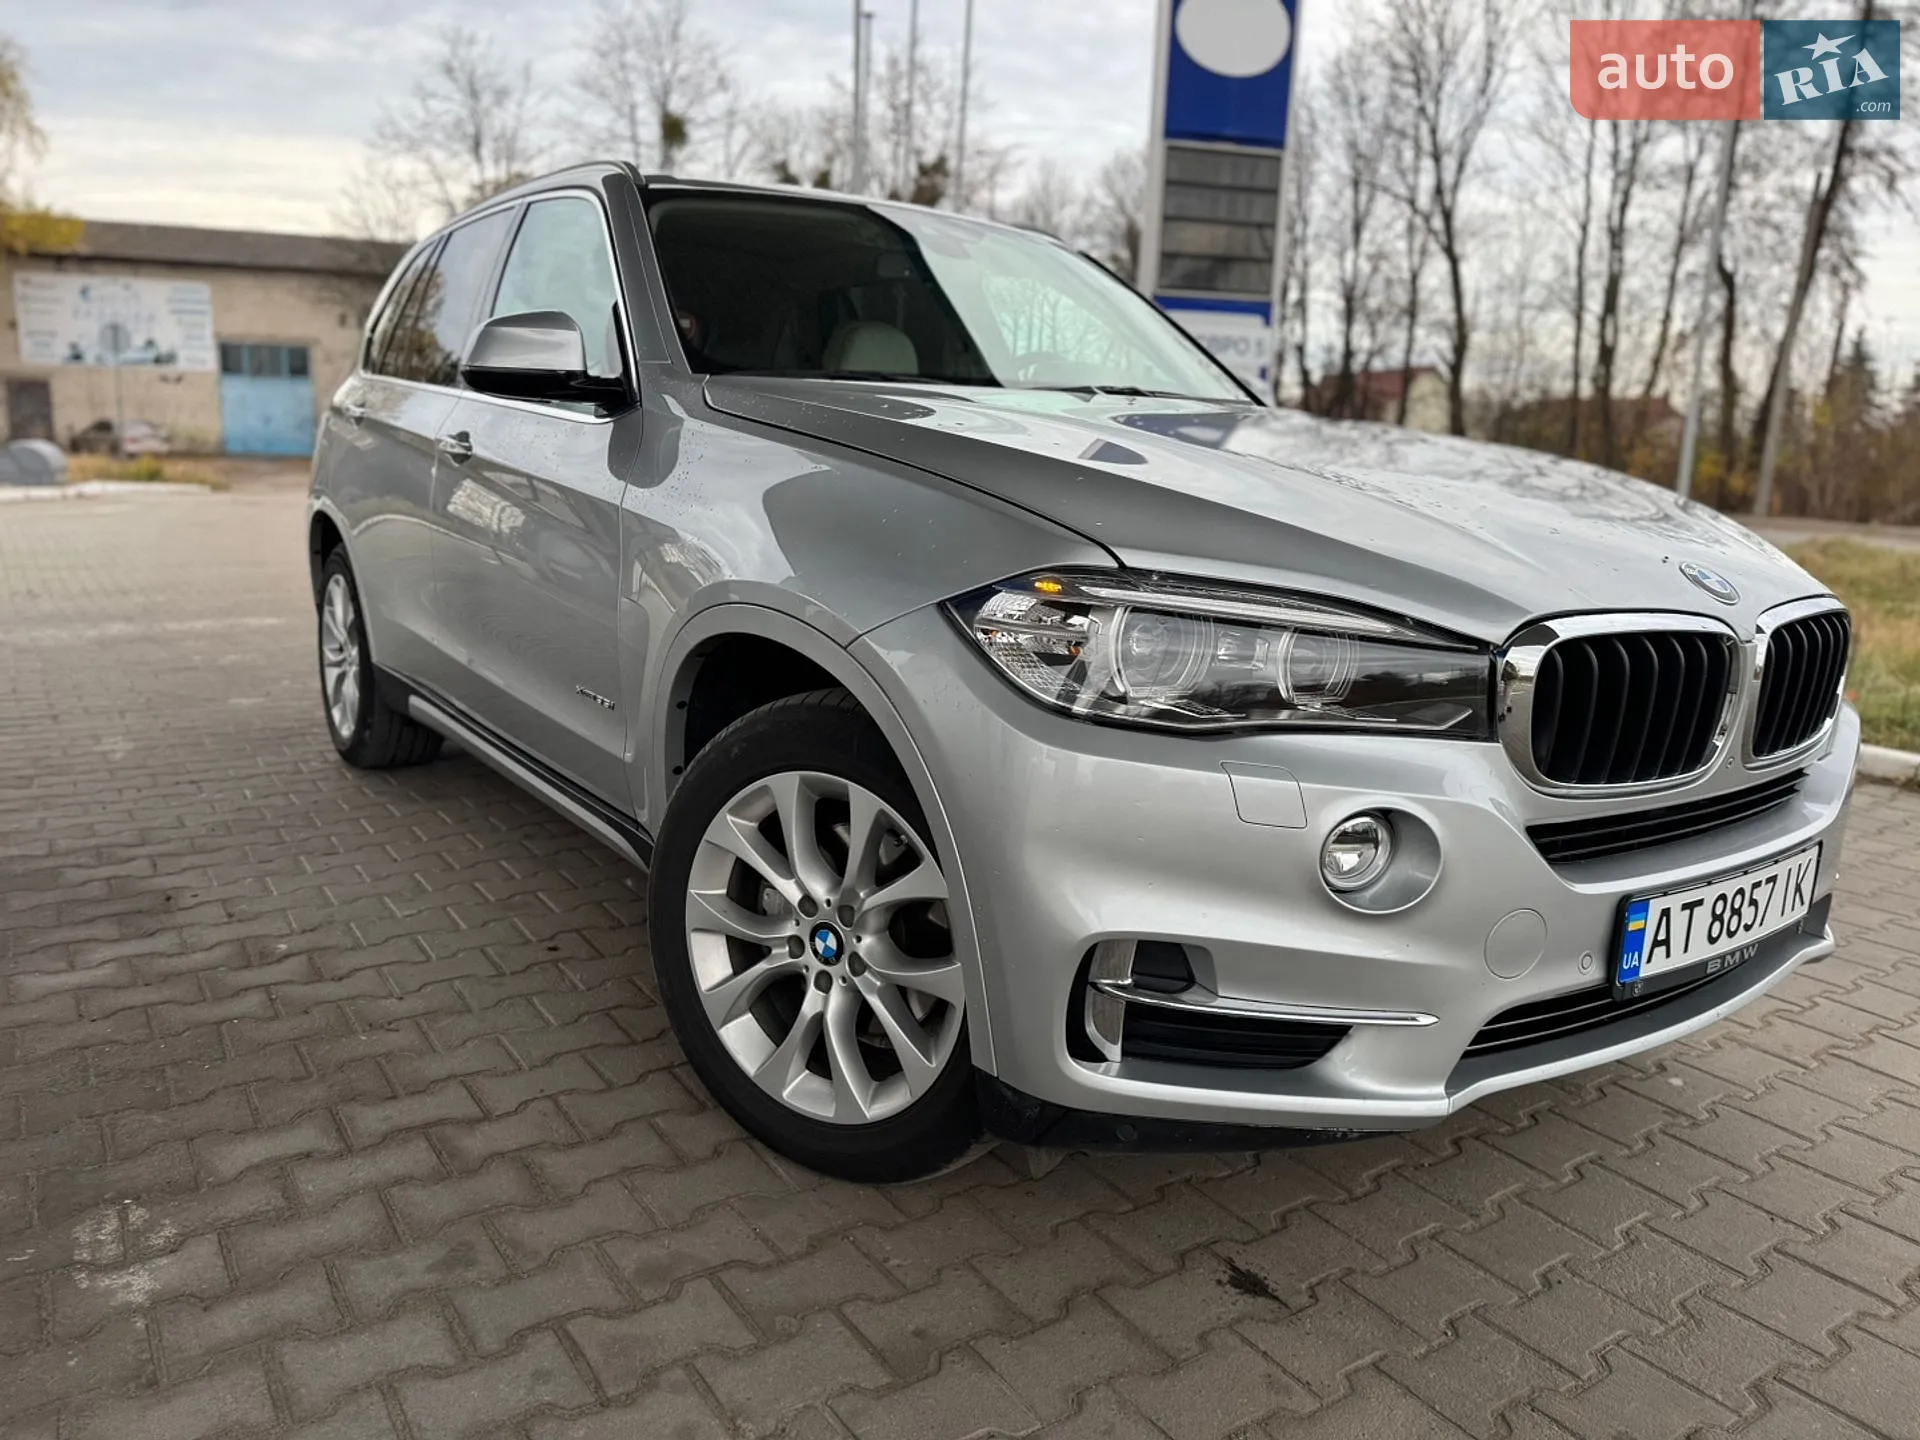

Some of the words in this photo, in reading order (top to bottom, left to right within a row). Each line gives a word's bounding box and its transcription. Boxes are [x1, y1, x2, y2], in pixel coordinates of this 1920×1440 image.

[1647, 898, 1705, 964] AT
[1707, 875, 1778, 945] 8857
[1781, 858, 1812, 917] IK
[1622, 953, 1640, 970] UA
[1706, 944, 1760, 974] BMW
